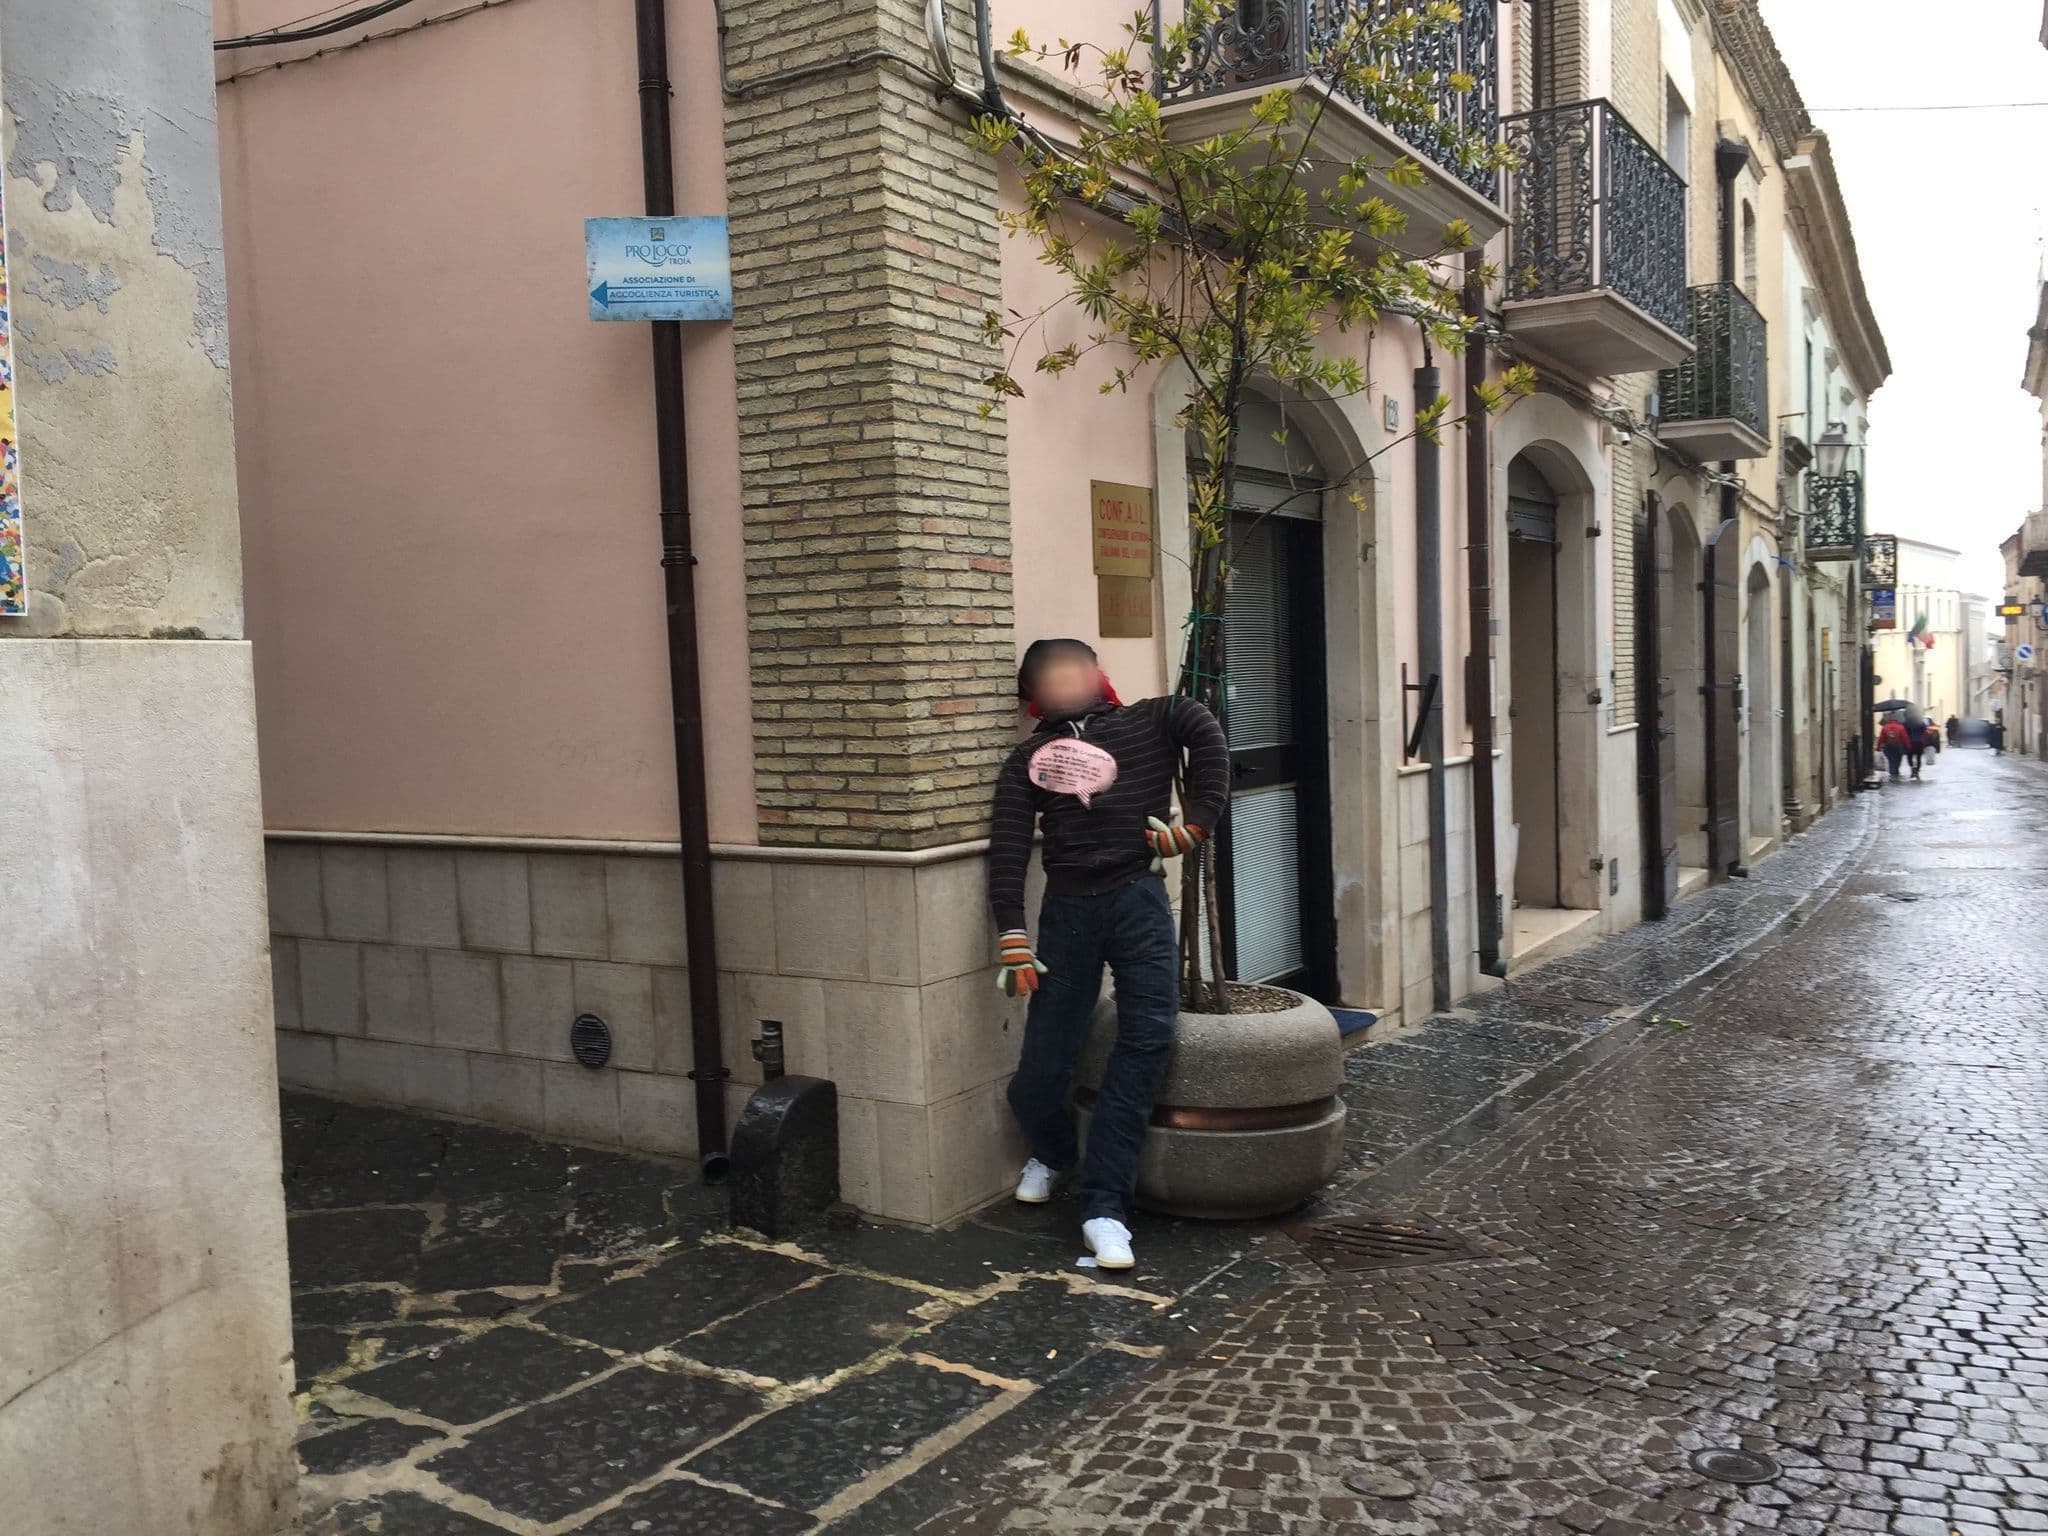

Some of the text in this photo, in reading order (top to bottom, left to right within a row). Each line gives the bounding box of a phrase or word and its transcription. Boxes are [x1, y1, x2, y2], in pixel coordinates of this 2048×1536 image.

[625, 245, 650, 258] PRO
[623, 276, 684, 284] ASSOCIAZIONE
[610, 290, 720, 298] ACCOGLIENZA TURISTICA
